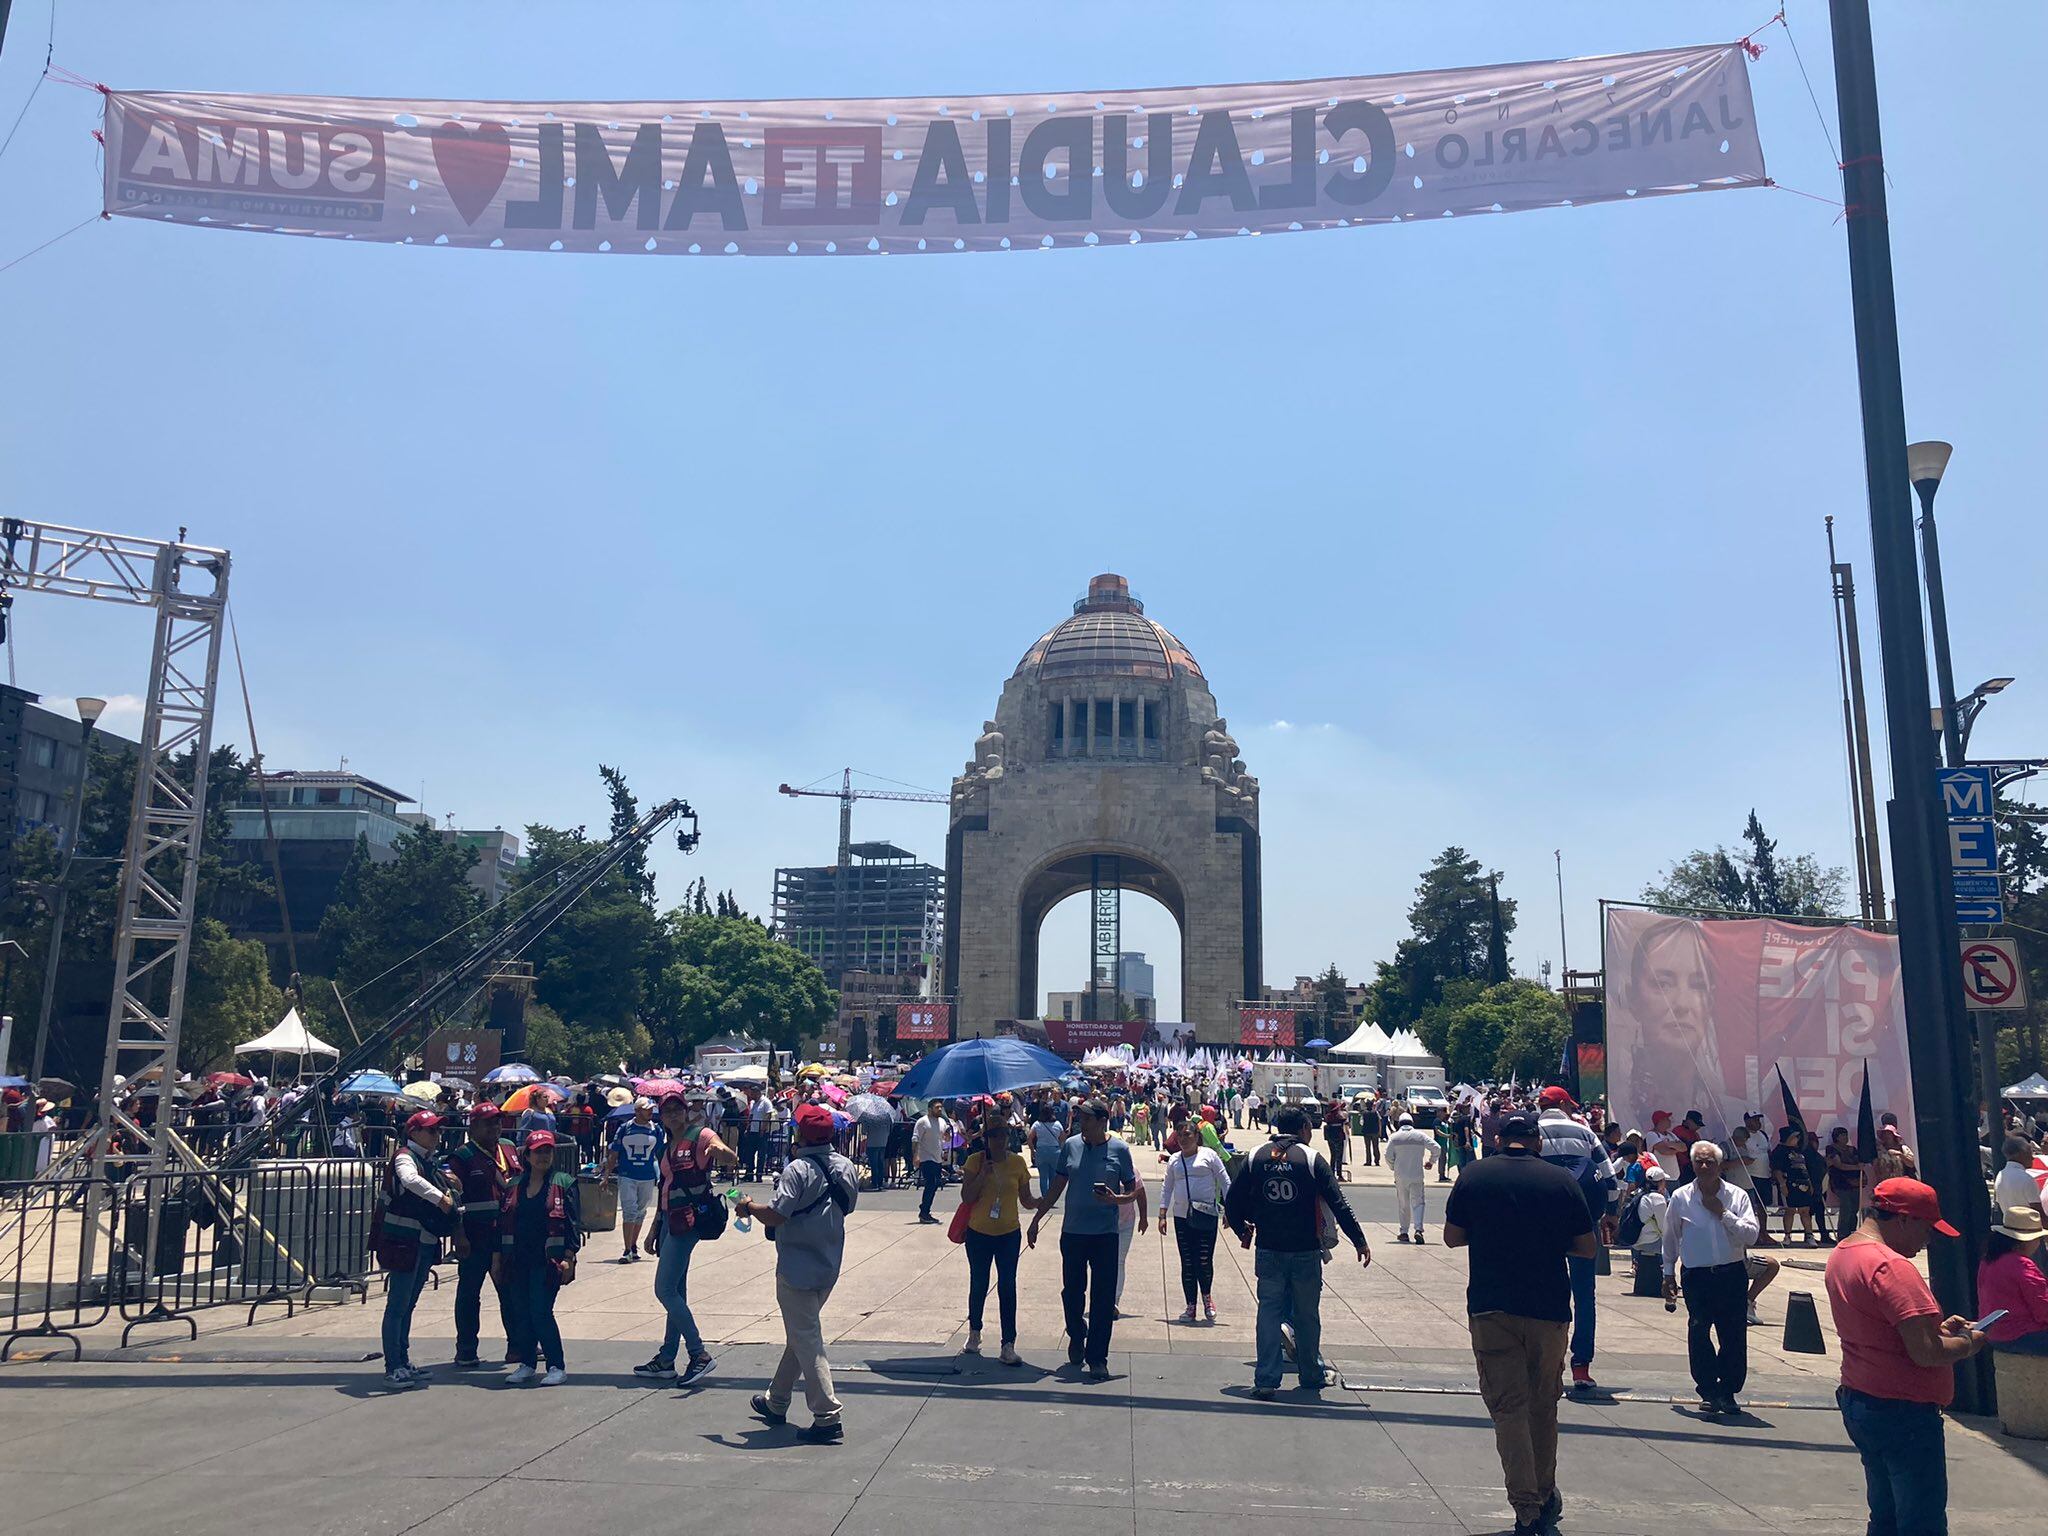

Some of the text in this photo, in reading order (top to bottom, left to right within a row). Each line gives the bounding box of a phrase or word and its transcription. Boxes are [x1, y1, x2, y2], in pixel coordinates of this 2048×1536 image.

[1949, 825, 1987, 867] E
[1099, 889, 1111, 954] ABIERTO
[1264, 1162, 1293, 1171] ESPAÑA
[1267, 1180, 1293, 1201] 30
